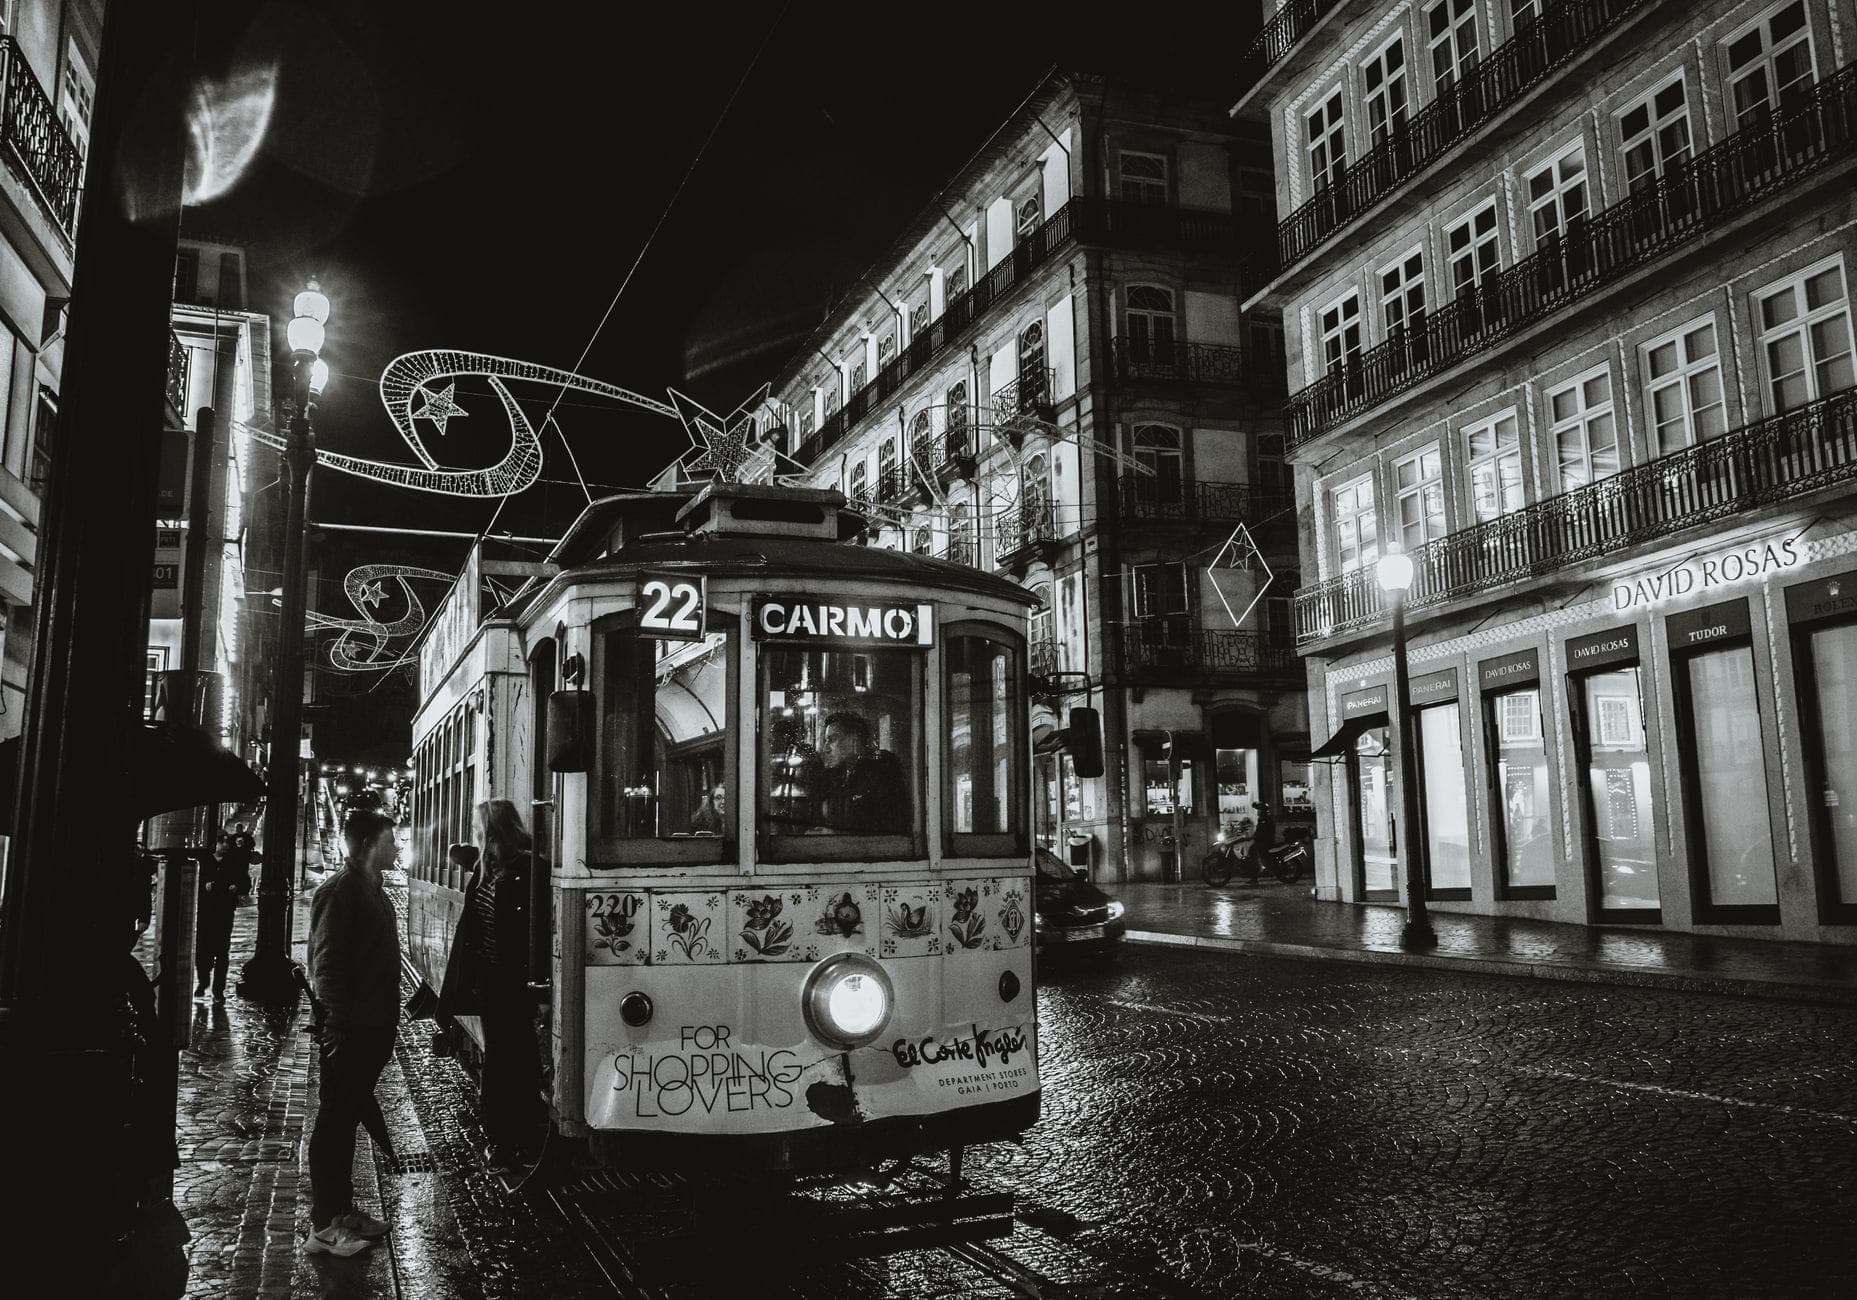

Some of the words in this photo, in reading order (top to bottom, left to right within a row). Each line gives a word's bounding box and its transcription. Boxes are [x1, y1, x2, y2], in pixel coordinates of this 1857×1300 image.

[1613, 568, 1694, 610] DAVID
[1702, 538, 1797, 587] ROSAS
[640, 580, 699, 631] 22
[761, 602, 912, 639] CARMO
[1688, 624, 1727, 642] TUDOR
[1574, 644, 1600, 659] DAVID
[1601, 637, 1629, 653] ROSAS
[1485, 665, 1507, 680] DAVID
[1508, 660, 1531, 673] ROSAS
[1412, 679, 1451, 695] PANERAI
[1346, 695, 1382, 710] PANERAI
[590, 894, 637, 918] 220
[680, 1025, 731, 1051] FOR
[892, 1038, 921, 1068] El
[919, 1036, 974, 1064] Corte
[612, 1050, 805, 1091] SHOPPING
[938, 1071, 996, 1088] DEPARTMENT
[999, 1067, 1028, 1081] STORES
[636, 1071, 793, 1118] LOVERS
[958, 1084, 982, 1096] GAIA
[993, 1079, 1018, 1092] PORTO
